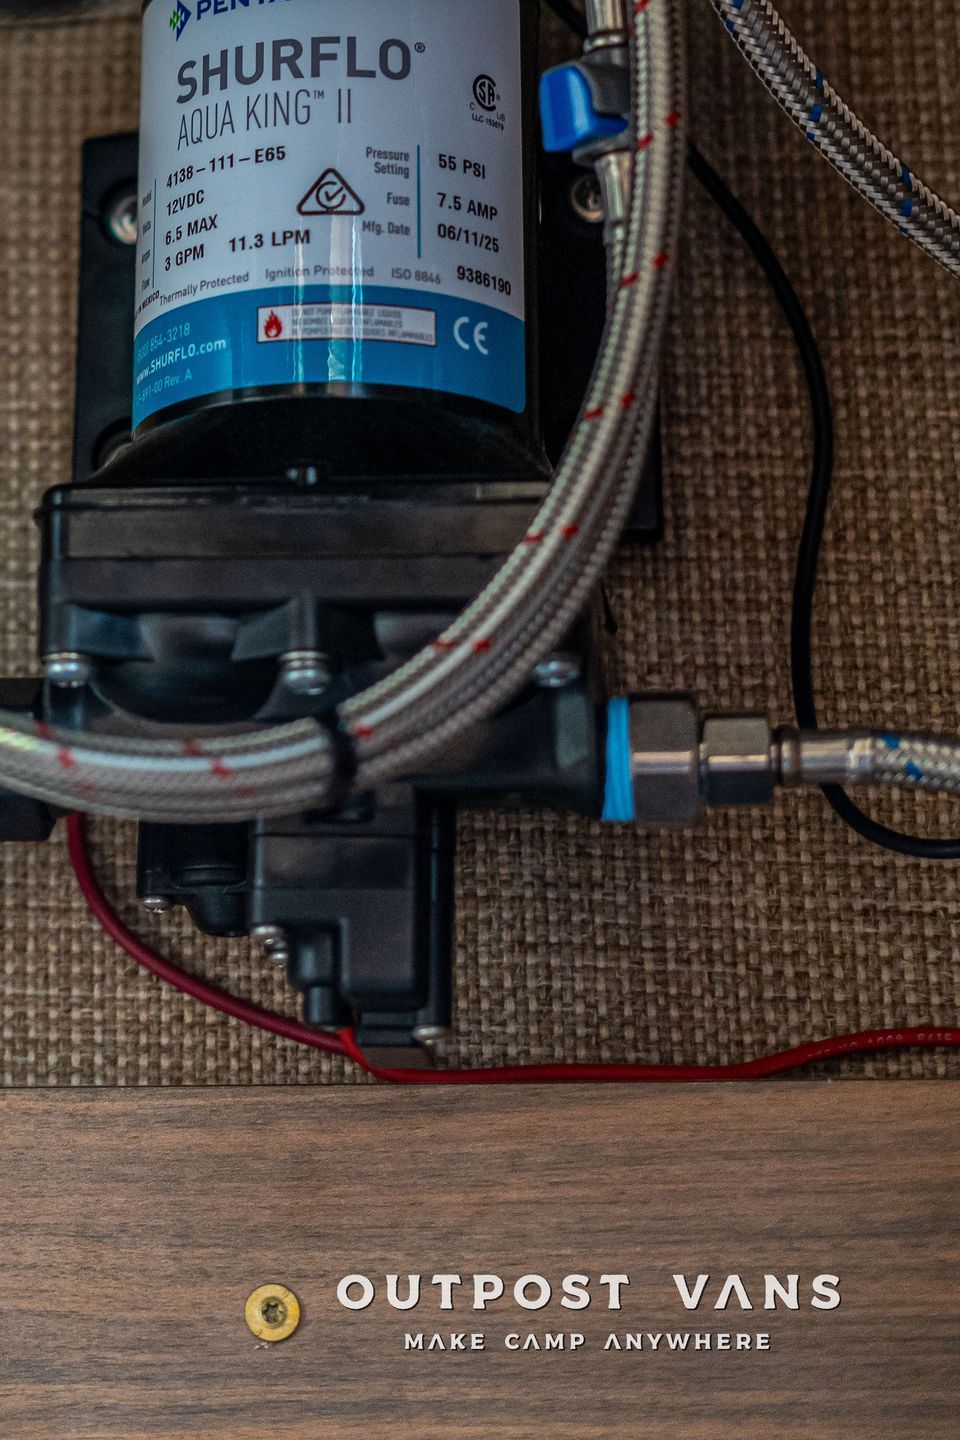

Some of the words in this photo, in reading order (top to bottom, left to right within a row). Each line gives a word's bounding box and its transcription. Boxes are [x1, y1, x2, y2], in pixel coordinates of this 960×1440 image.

[177, 100, 235, 151] AQUA
[337, 88, 352, 124] II
[365, 146, 410, 162] Pressure
[438, 153, 457, 171] 55
[463, 159, 486, 179] PSI
[374, 162, 410, 179] Setting
[166, 189, 205, 216] 12VDC
[386, 192, 410, 206] Fuse
[437, 192, 462, 211] 7.5
[467, 199, 498, 221] AMP
[165, 225, 182, 246] 6.5
[187, 214, 218, 237] MAX
[362, 220, 385, 236] Mfg.
[387, 222, 410, 236] Date
[437, 223, 500, 254] 06/11/25
[164, 256, 171, 273] 3
[175, 244, 204, 267] GPM
[228, 233, 265, 253] 11.3
[271, 229, 311, 247] LPM
[160, 283, 198, 307] Thermally
[200, 271, 250, 292] Protected
[265, 267, 310, 282] Ignition
[392, 267, 412, 280] ISO
[415, 269, 442, 285] 8846
[456, 265, 512, 296] 9386190
[141, 290, 160, 313] MEXICO
[453, 316, 489, 355] CE
[184, 368, 193, 382] A
